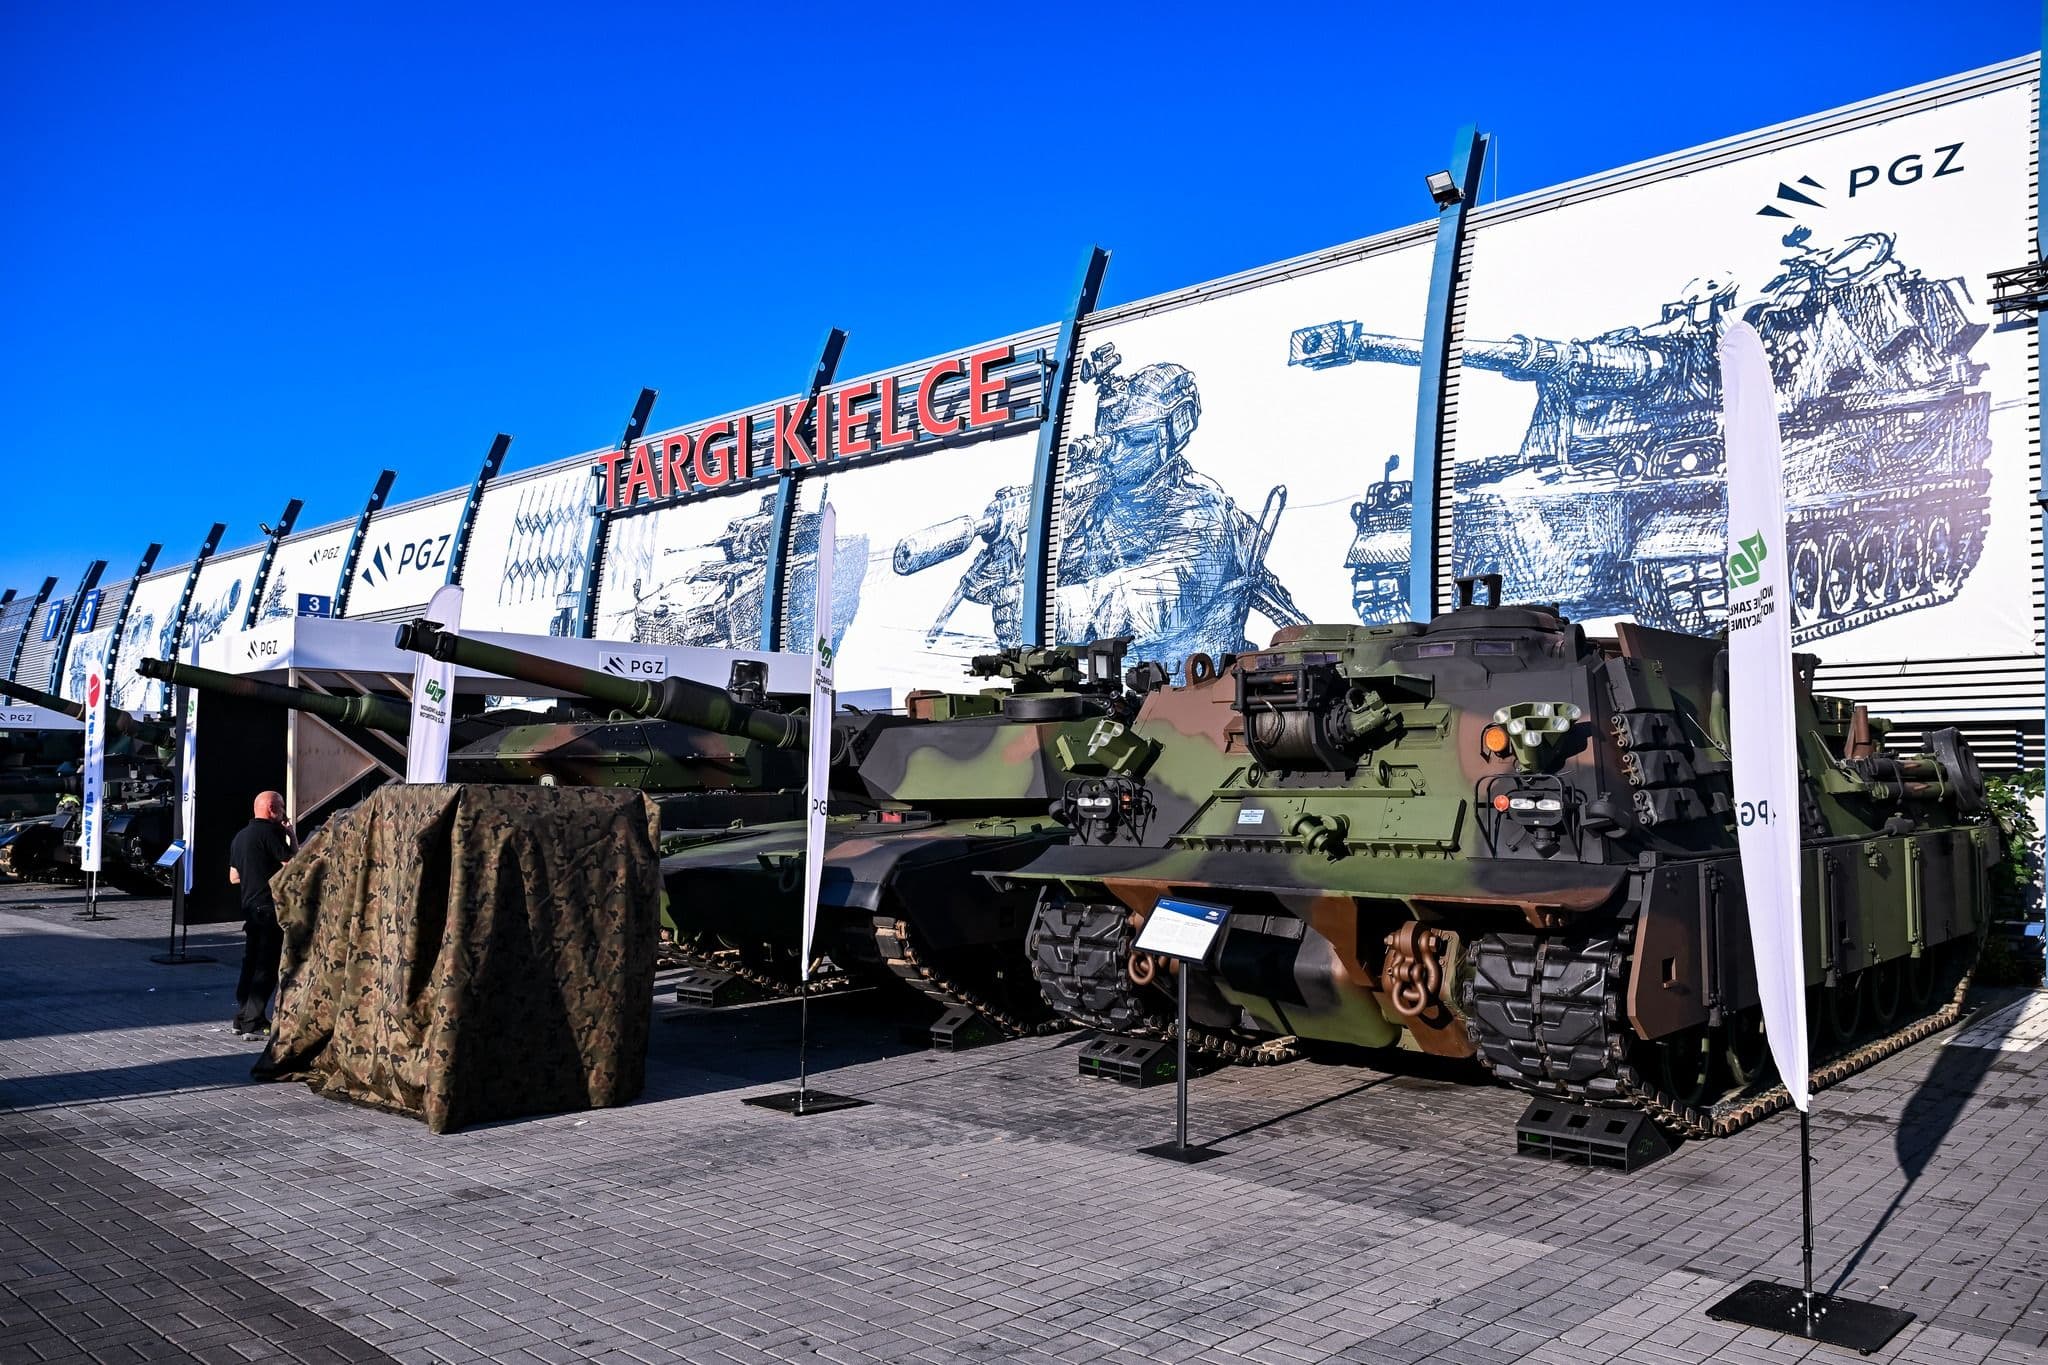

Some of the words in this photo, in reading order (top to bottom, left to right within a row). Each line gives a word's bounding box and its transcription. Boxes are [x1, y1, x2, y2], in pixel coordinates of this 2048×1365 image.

[1849, 142, 1965, 198] PGZ
[599, 415, 752, 510] TARGI
[773, 345, 1015, 470] KIELCE
[322, 546, 340, 560] PGZ
[398, 534, 452, 575] PGZ
[309, 597, 320, 611] 3
[47, 611, 57, 637] 1
[81, 601, 93, 629] 3
[260, 640, 278, 656] PGZ
[631, 660, 664, 674] PGZ
[10, 714, 33, 722] PGZ
